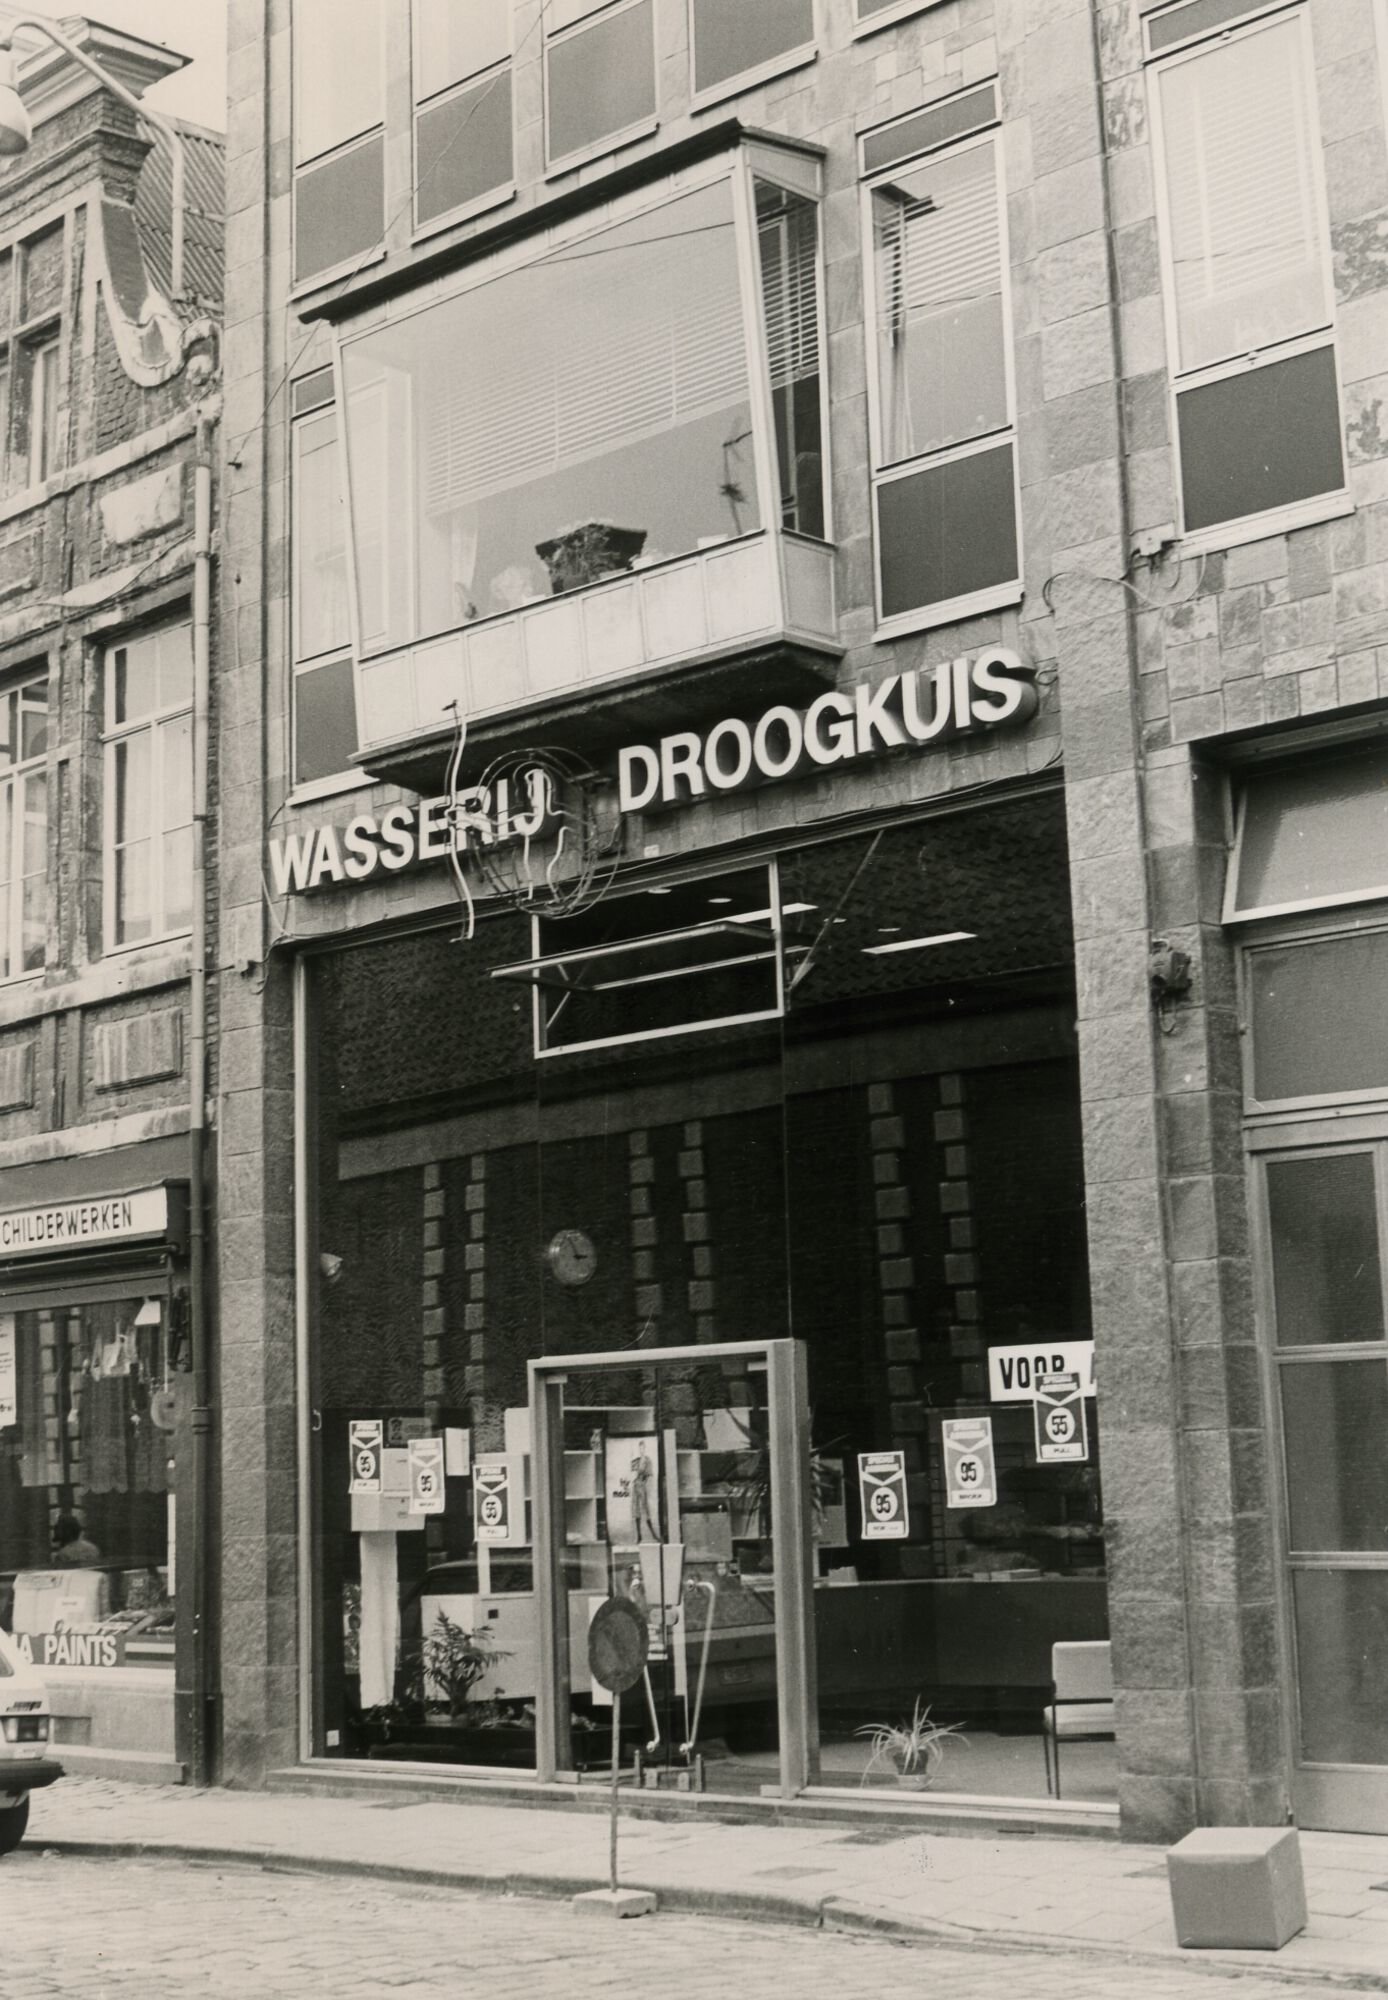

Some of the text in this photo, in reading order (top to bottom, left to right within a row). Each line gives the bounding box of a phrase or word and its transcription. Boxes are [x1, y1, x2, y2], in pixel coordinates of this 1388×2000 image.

[270, 649, 1024, 895] WASSERIJ DROOGKUIS
[1052, 1415, 1068, 1435] 55
[961, 1462, 977, 1482] 95
[876, 1494, 891, 1513] 95
[44, 1634, 117, 1667] PAINTS
